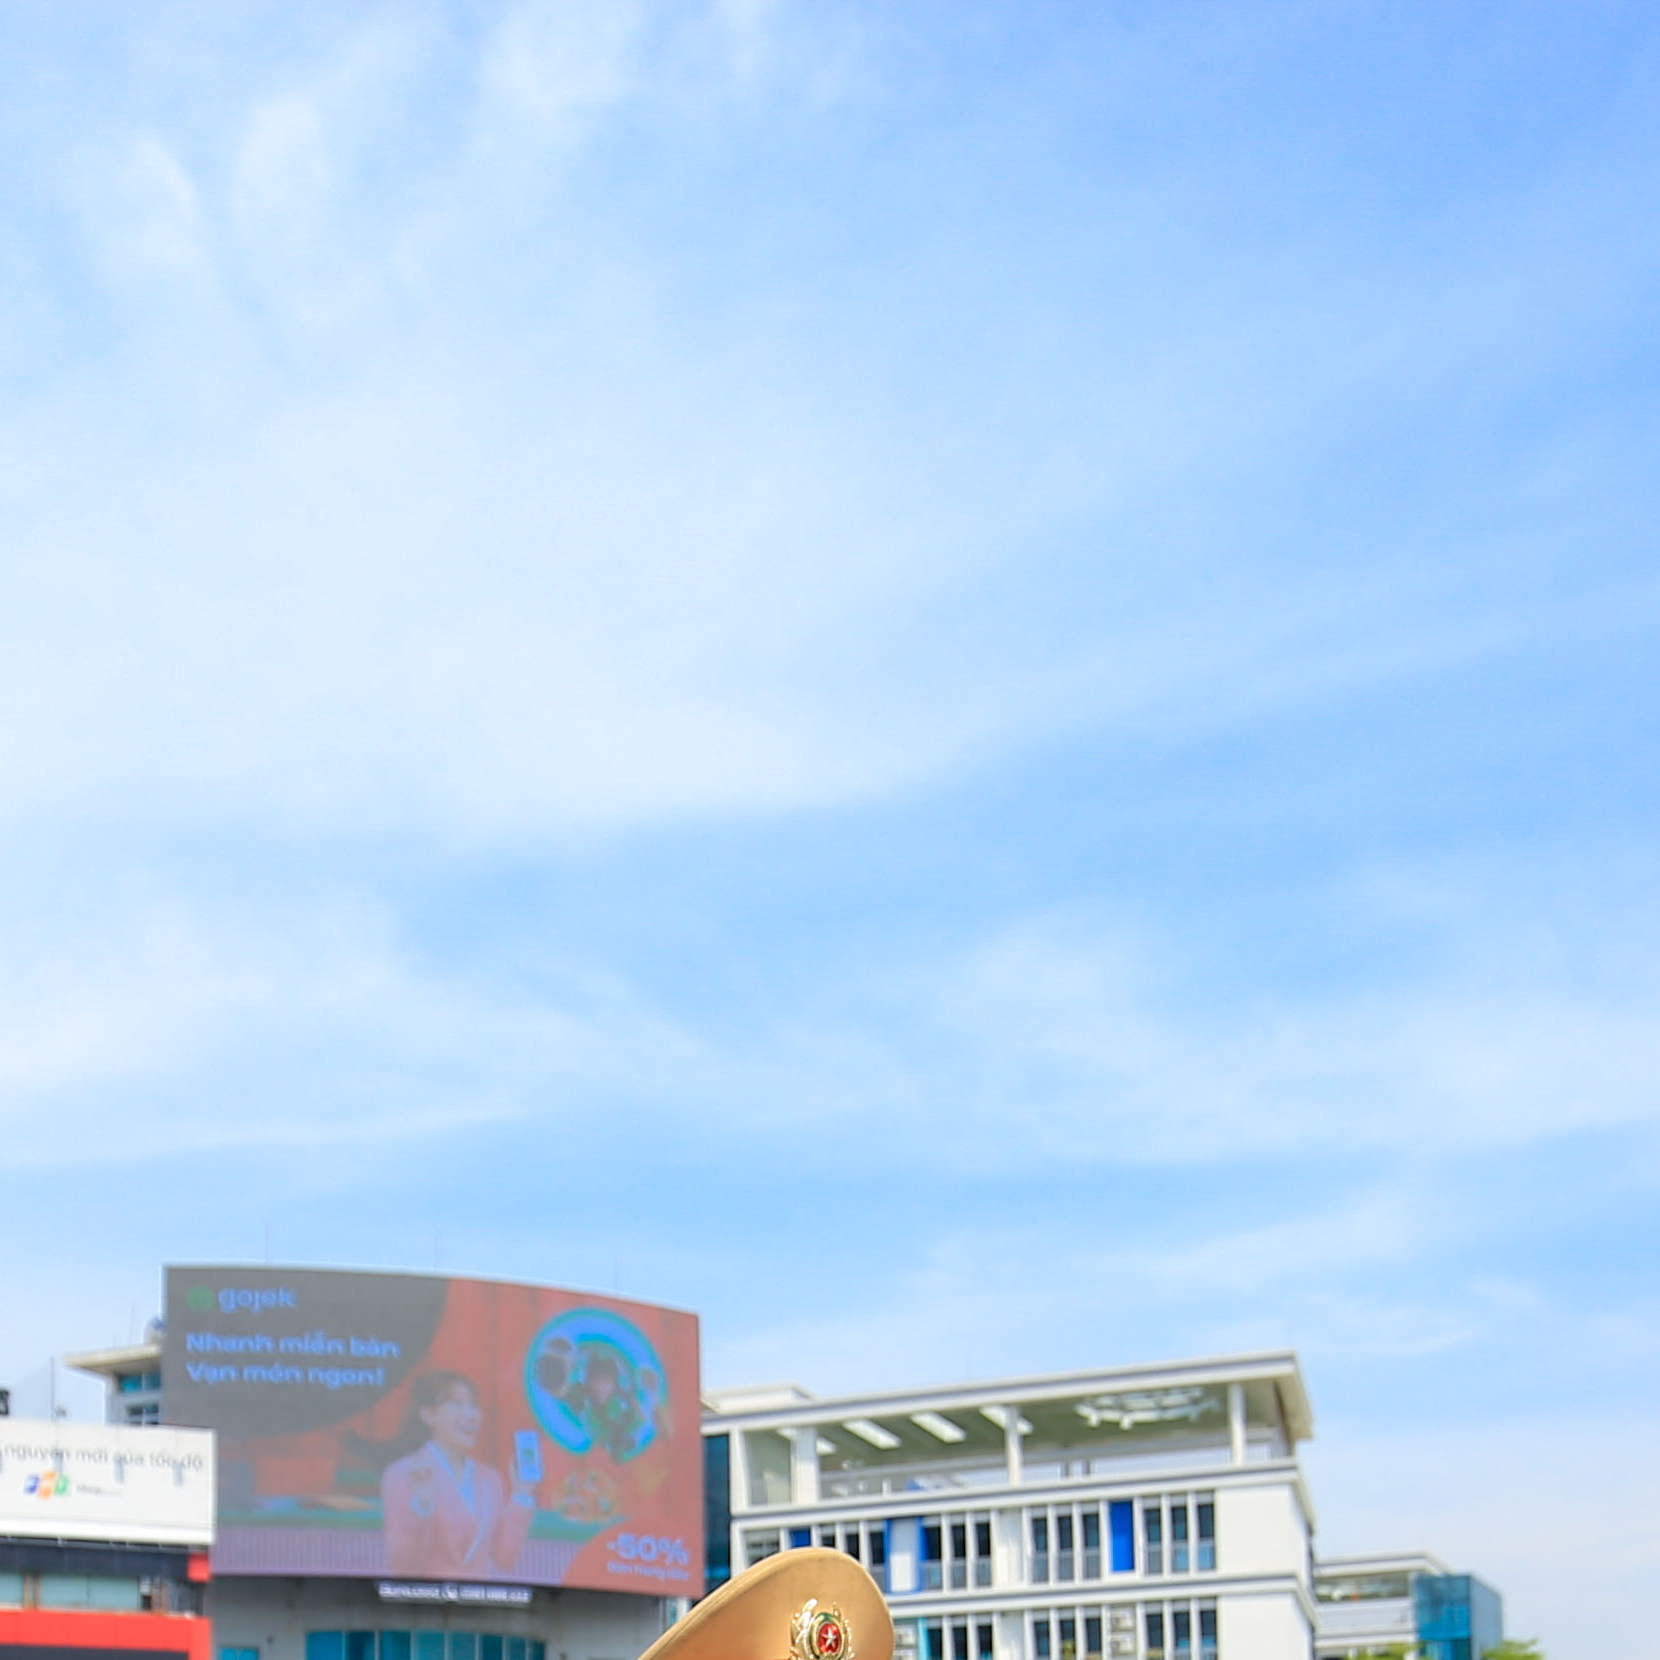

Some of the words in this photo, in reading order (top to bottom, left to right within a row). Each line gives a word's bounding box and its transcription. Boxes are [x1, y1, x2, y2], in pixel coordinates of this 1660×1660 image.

[218, 1287, 296, 1314] gojek
[186, 1332, 274, 1353] Nhanh
[186, 1363, 237, 1387] Vạn
[243, 1362, 301, 1384] món
